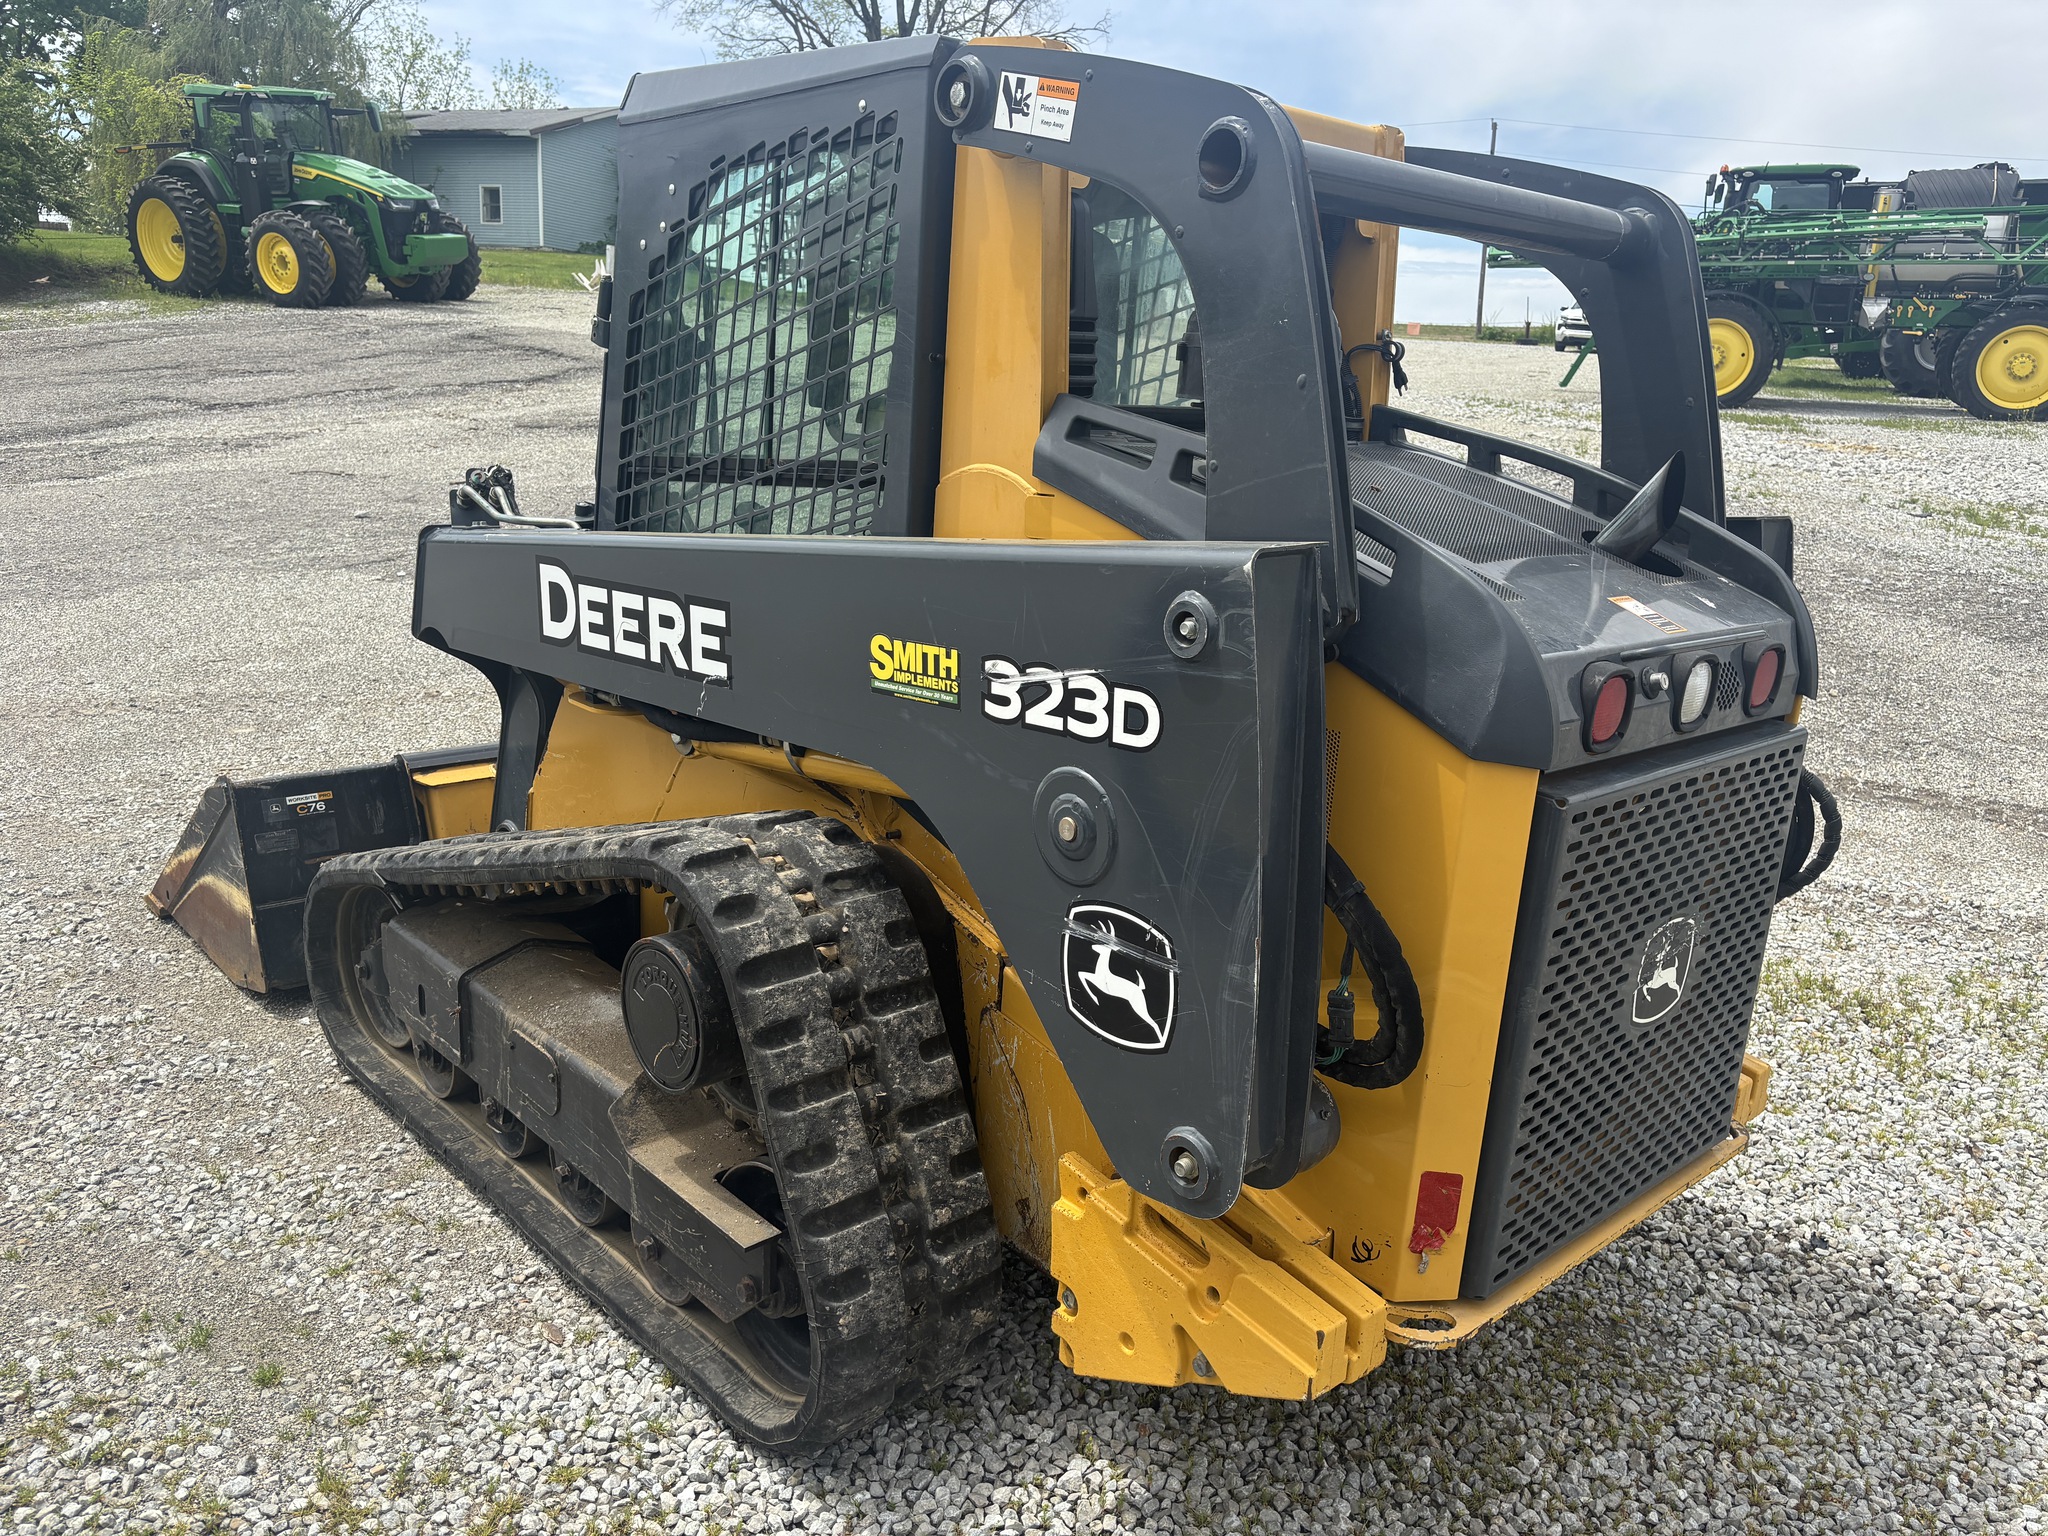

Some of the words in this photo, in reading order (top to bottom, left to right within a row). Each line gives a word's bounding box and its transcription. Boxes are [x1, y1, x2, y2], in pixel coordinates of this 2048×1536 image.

[1046, 84, 1075, 95] WARNING
[1040, 104, 1055, 113] Pinch
[1056, 107, 1070, 116] Area
[1041, 119, 1052, 127] Keep
[1053, 121, 1064, 130] Away
[539, 563, 728, 678] DEERE
[870, 634, 958, 680] SMITH
[875, 681, 898, 690] Unmatched
[899, 685, 915, 694] Service
[941, 693, 953, 701] Years
[894, 671, 958, 693] IMPLEMENTS
[984, 659, 1161, 748] 323D
[297, 801, 326, 813] C76
